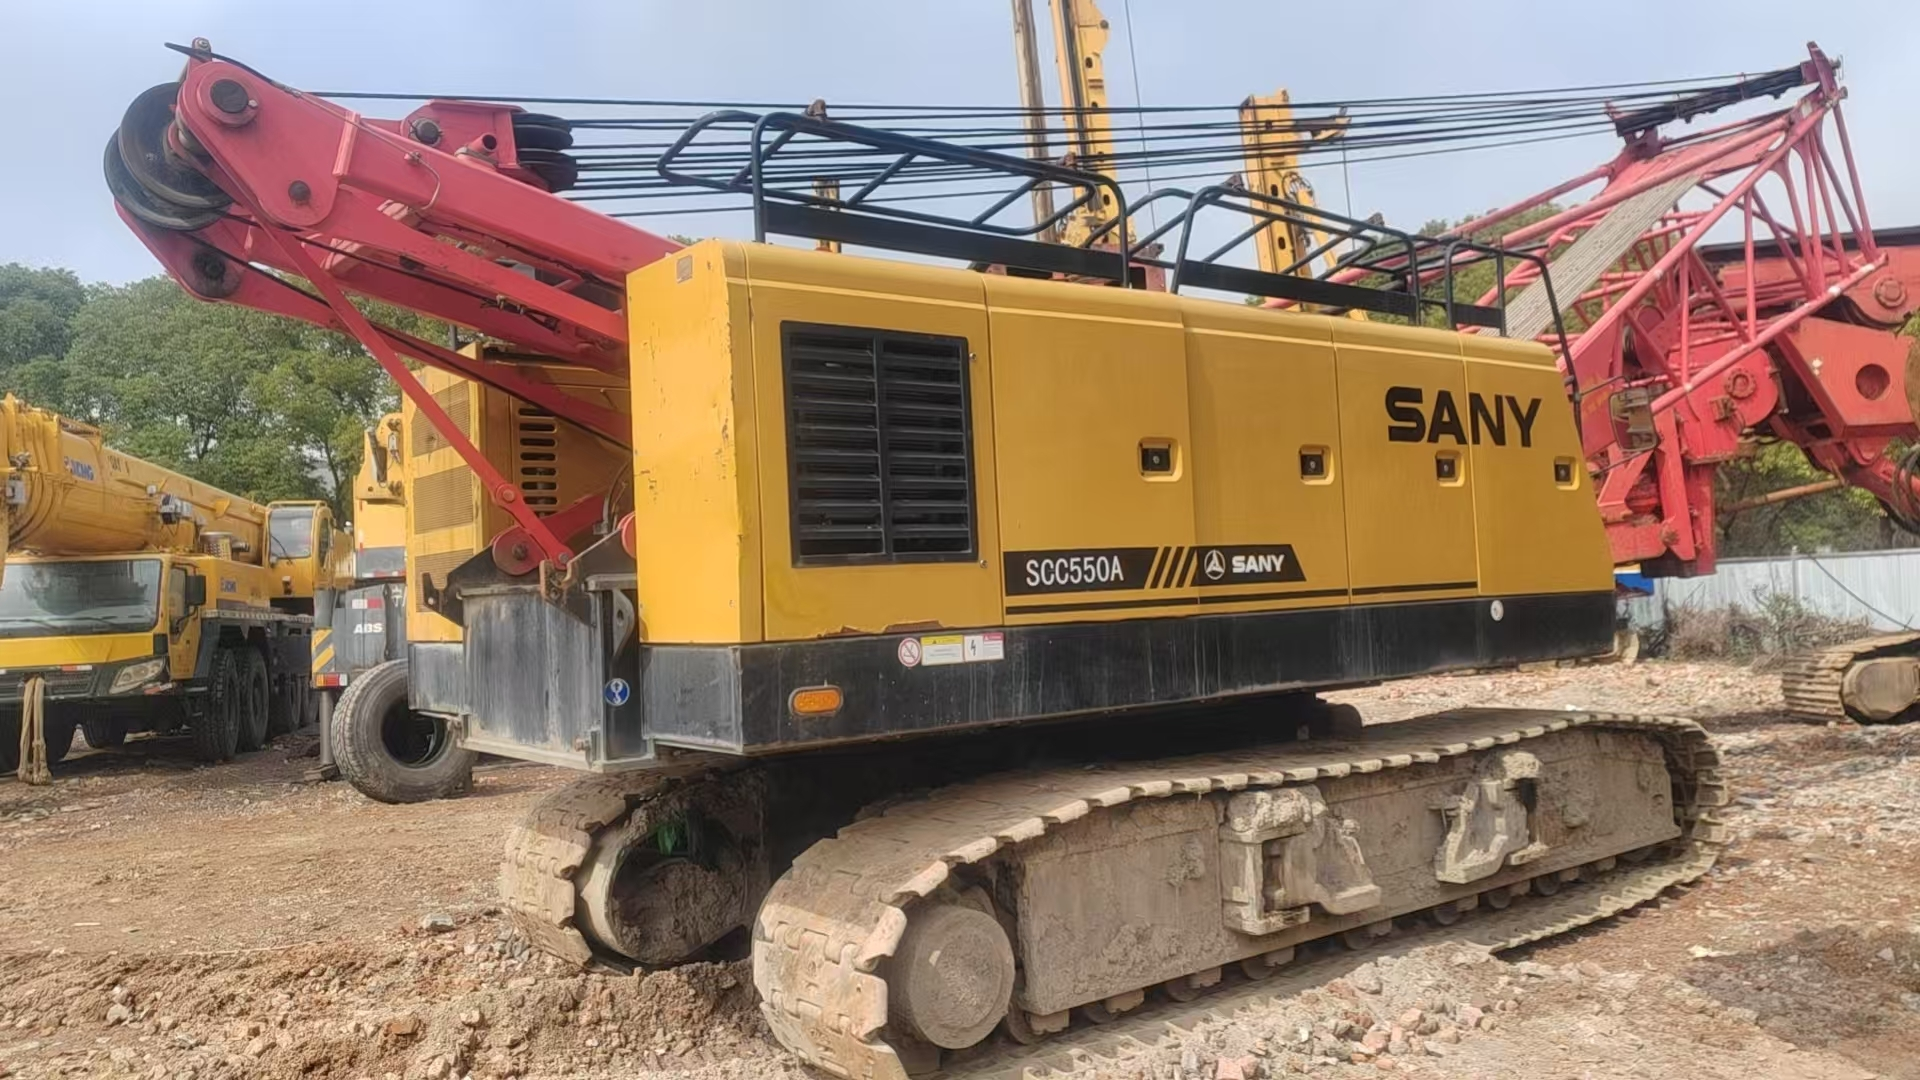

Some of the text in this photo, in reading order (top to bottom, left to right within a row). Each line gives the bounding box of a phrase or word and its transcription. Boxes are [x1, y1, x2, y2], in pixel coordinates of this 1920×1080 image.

[1385, 386, 1542, 447] SANY
[1026, 555, 1124, 586] SCC550A
[1231, 555, 1285, 573] SANY
[353, 623, 384, 634] ABS
